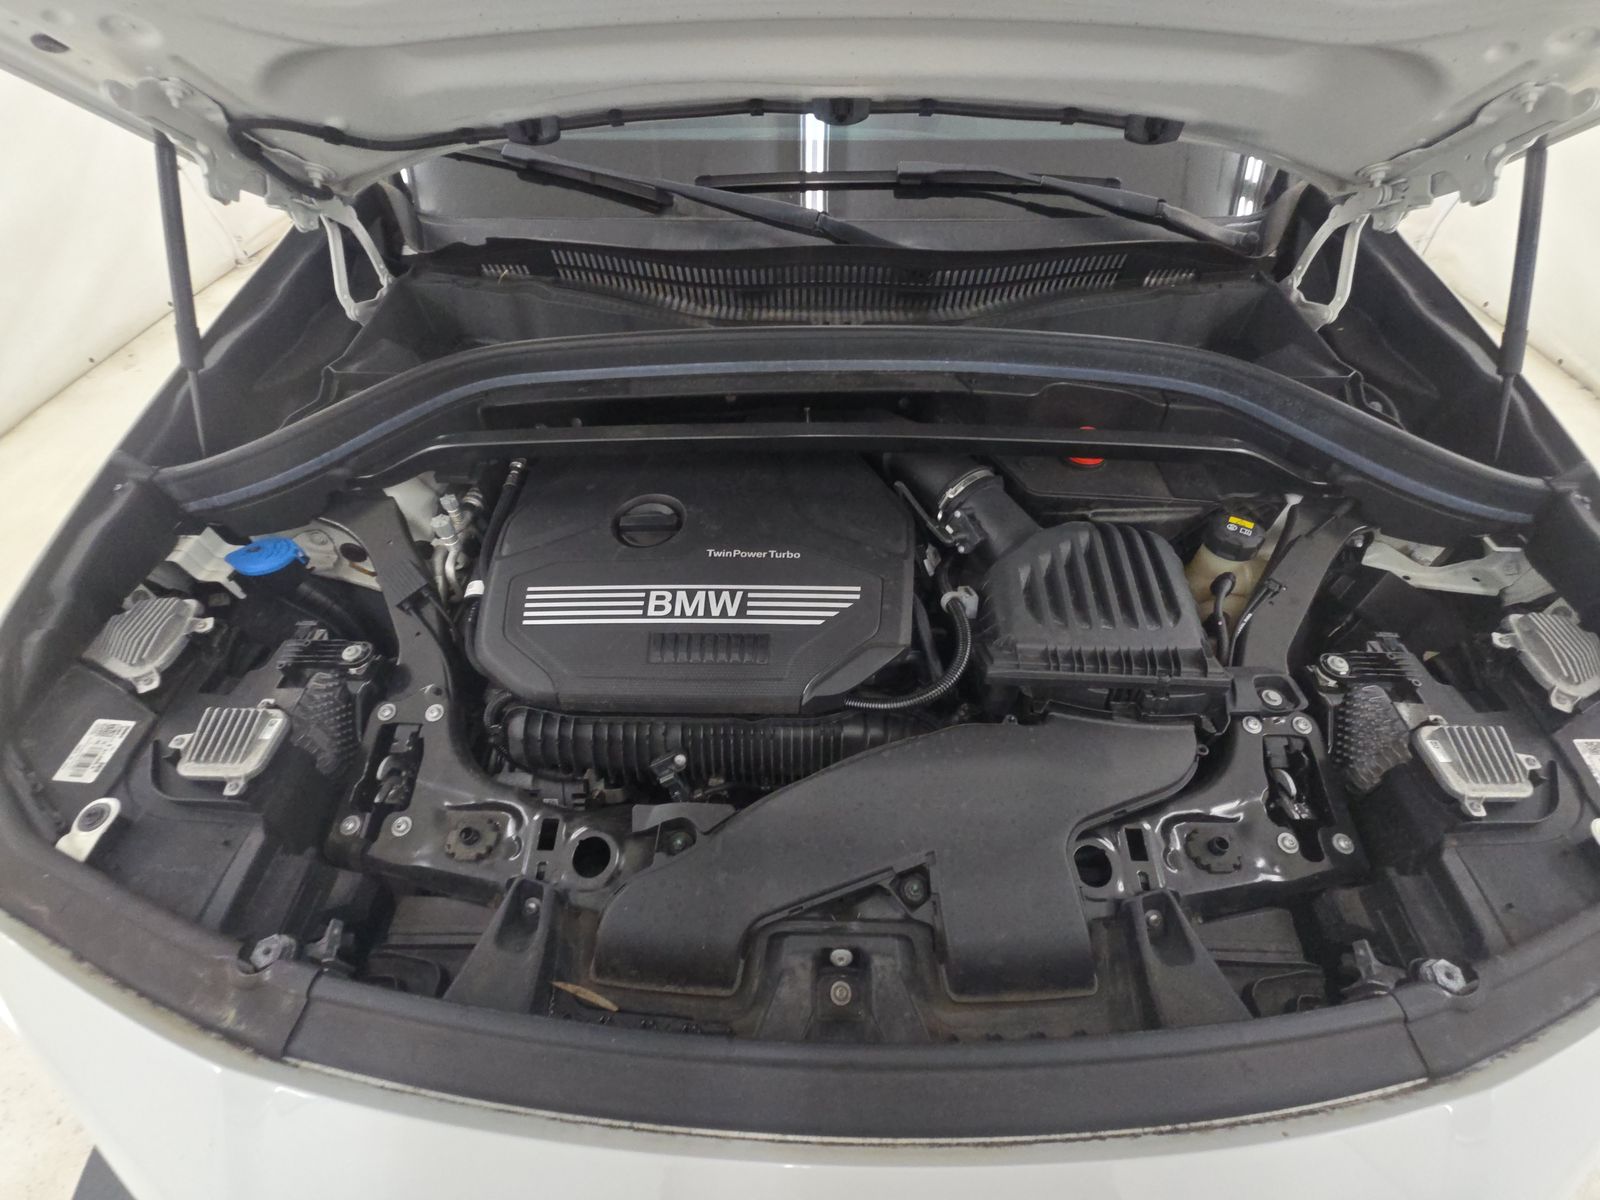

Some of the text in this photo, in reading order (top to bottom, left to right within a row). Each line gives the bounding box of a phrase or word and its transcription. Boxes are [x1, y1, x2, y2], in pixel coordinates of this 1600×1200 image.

[706, 549, 801, 559] TwinPower Turbo
[647, 591, 744, 617] BMW
